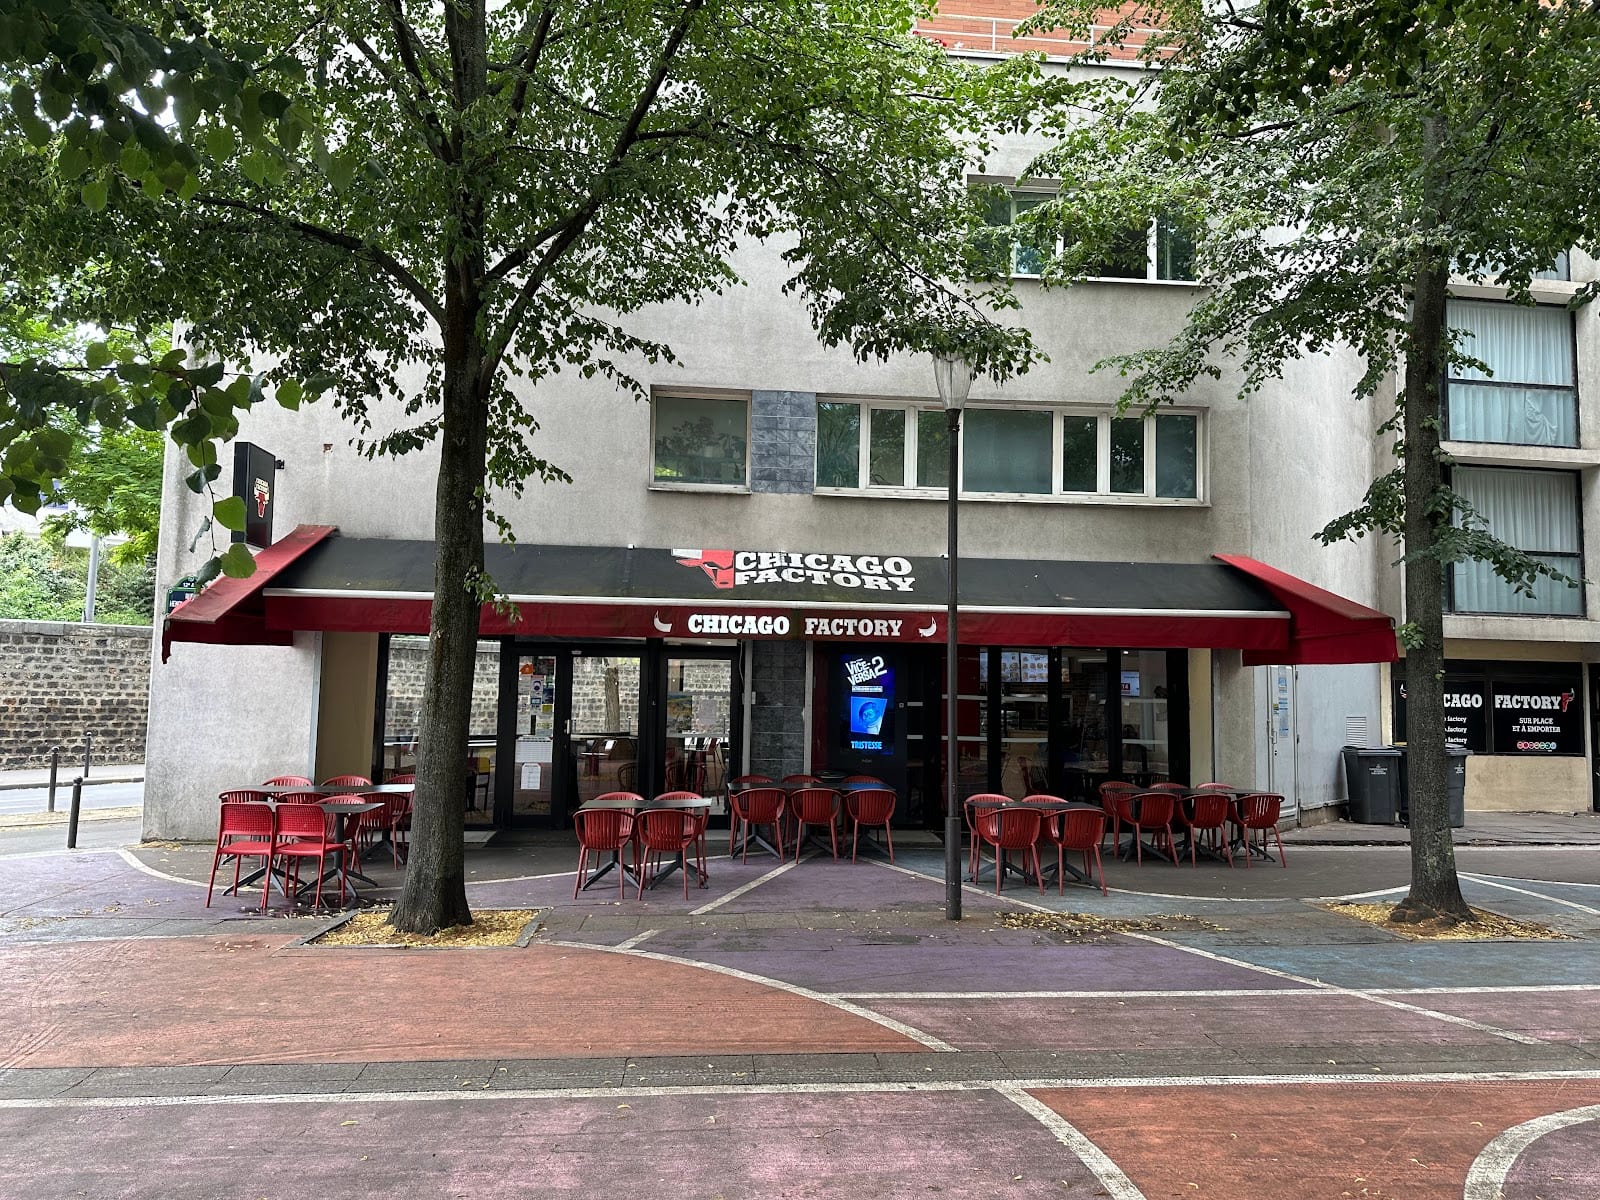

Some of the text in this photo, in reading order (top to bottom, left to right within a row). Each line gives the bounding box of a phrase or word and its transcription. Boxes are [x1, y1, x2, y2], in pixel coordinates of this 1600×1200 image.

[735, 551, 912, 576] CHICAGO
[735, 568, 916, 592] FACTORY
[688, 614, 902, 637] CHICAGO FACTORY
[847, 656, 888, 685] VERSA 2
[1494, 694, 1561, 710] FACTORY
[1447, 715, 1467, 723] factory
[1533, 717, 1554, 725] PLACE
[1527, 725, 1561, 733] EMPORTER
[850, 740, 883, 750] TRISTESSE
